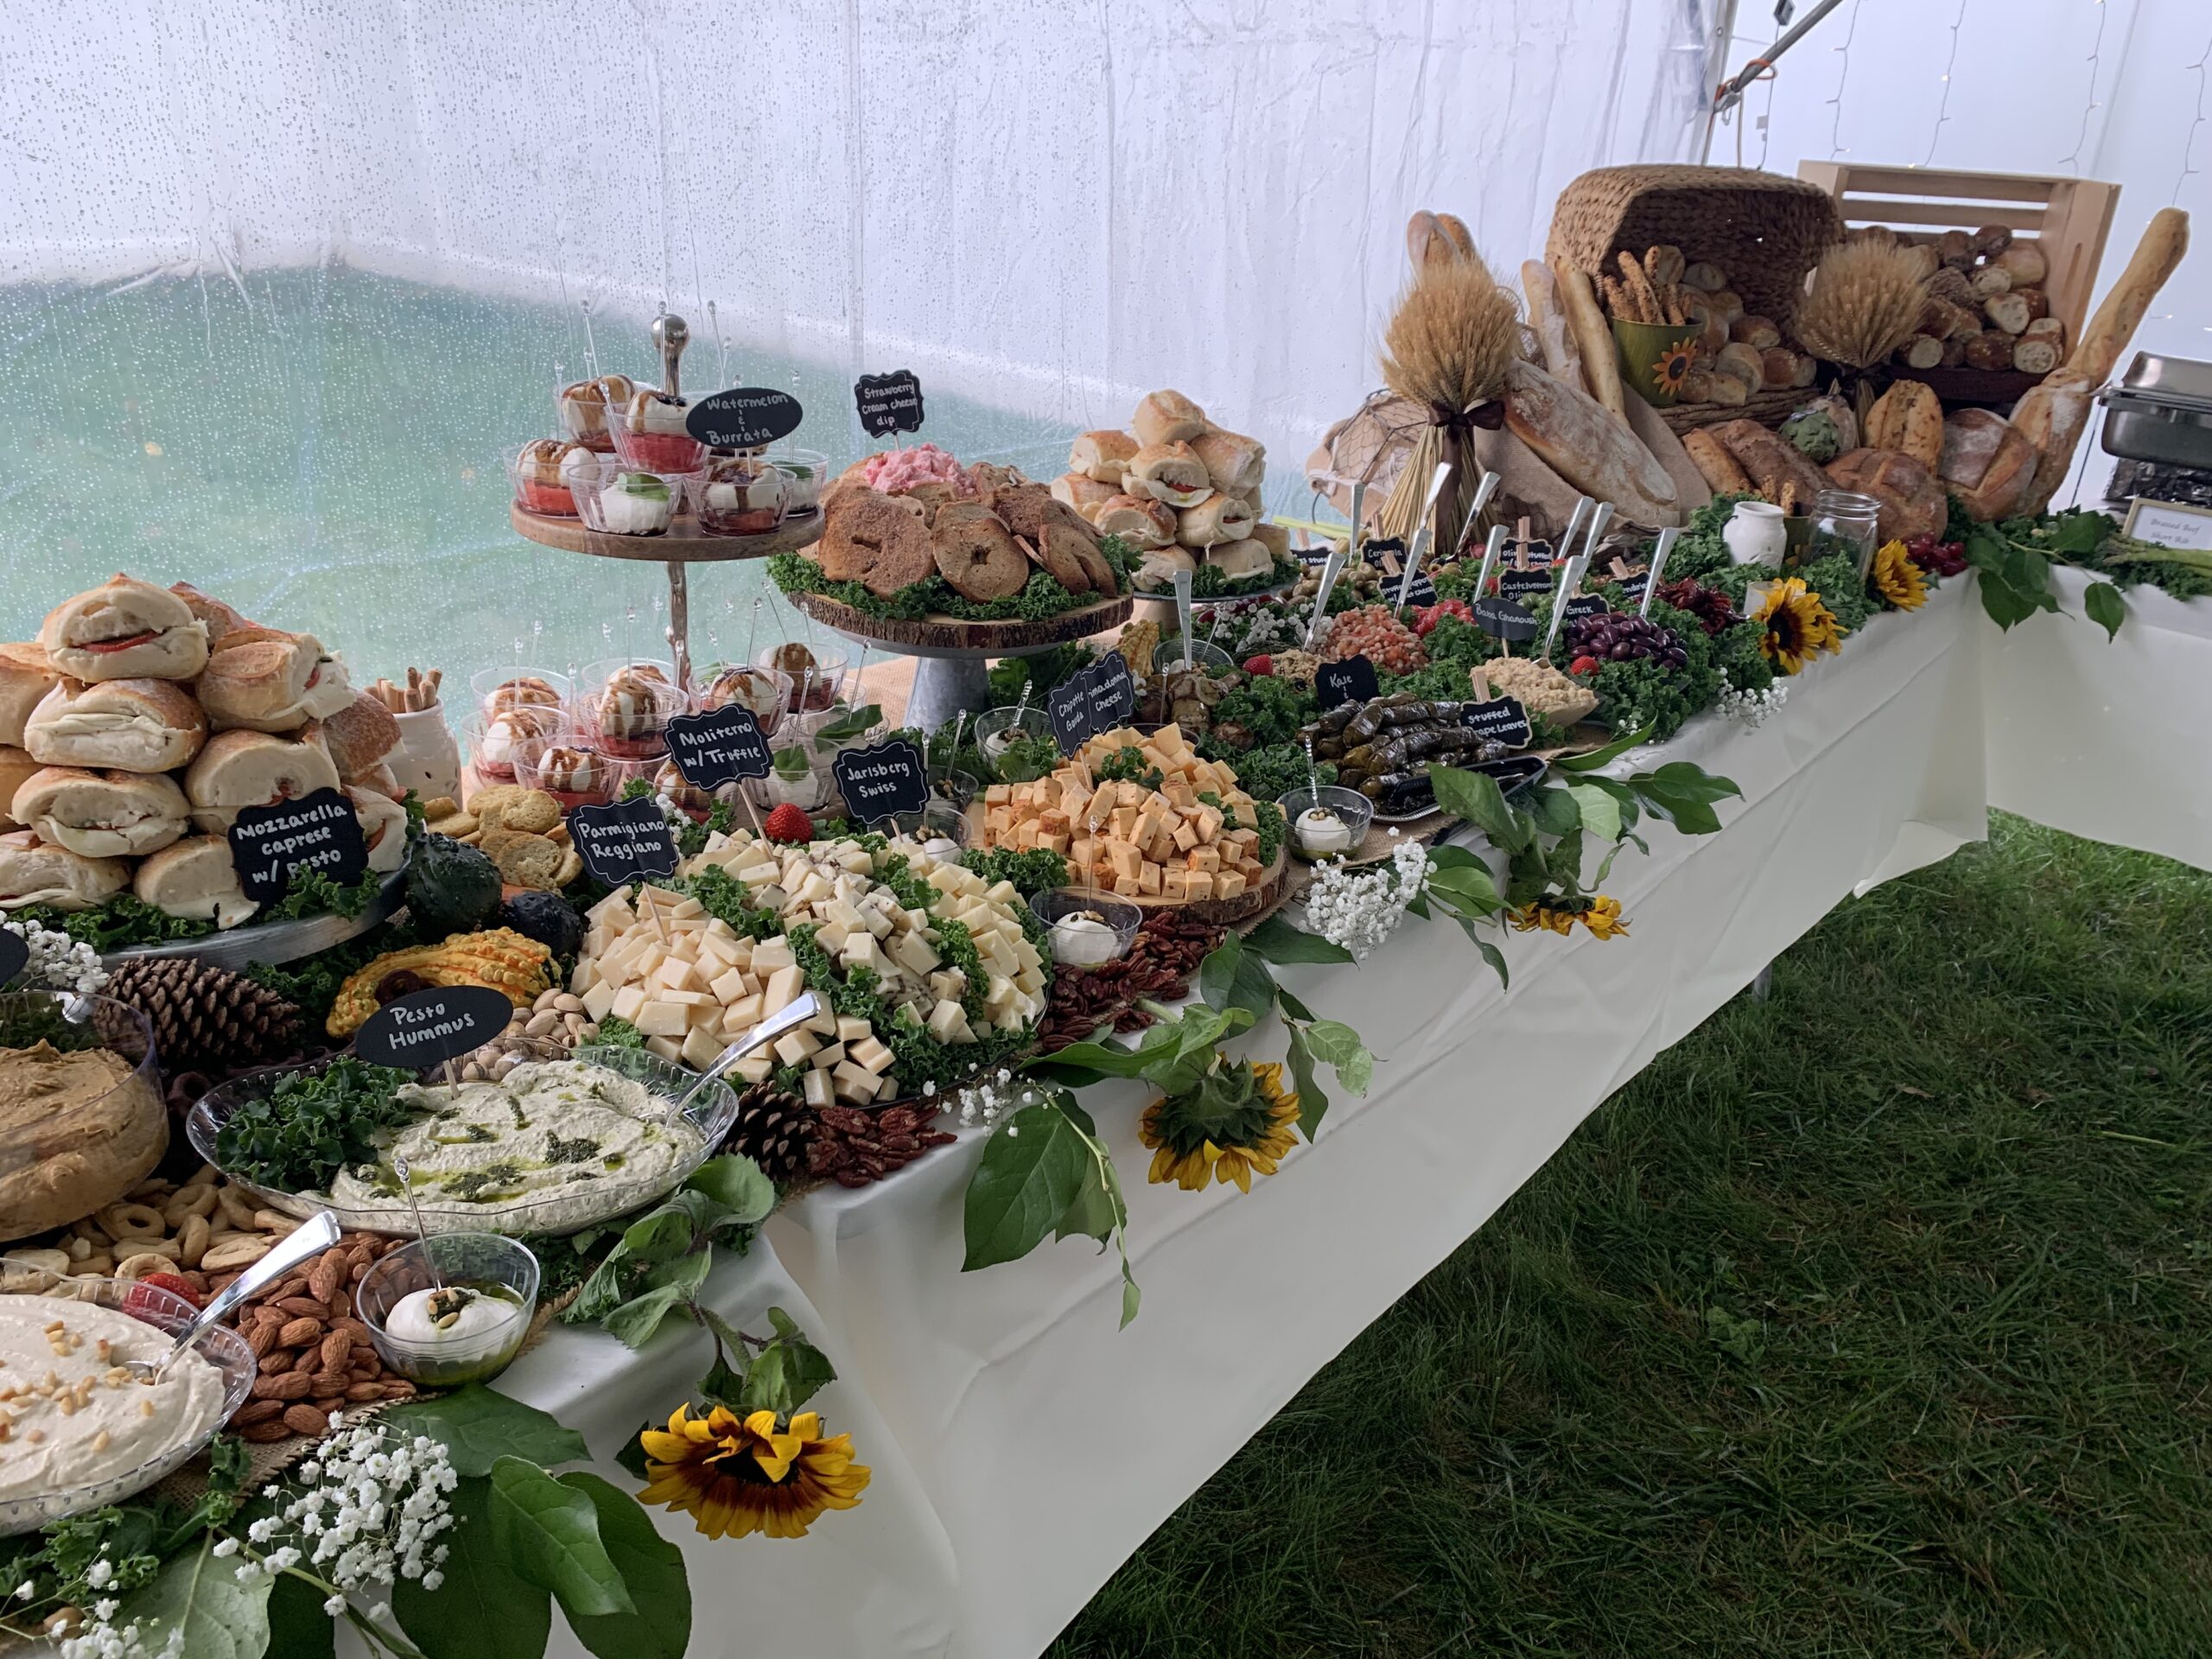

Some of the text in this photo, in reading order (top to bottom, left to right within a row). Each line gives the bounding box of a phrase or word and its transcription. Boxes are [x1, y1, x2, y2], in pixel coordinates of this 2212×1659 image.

[864, 384, 915, 398] Strawberry
[707, 395, 789, 410] Watermelon
[875, 416, 895, 426] dip
[706, 428, 773, 445] Burrata
[1566, 606, 1593, 615] Greek
[1330, 673, 1353, 688] Kale
[1058, 691, 1084, 717] Chipotle
[1065, 711, 1084, 732] Gouda
[678, 722, 753, 747] Moliterno
[848, 760, 910, 781] Jarlsberg
[859, 782, 897, 798] Swiss
[236, 804, 347, 840] Mozzarella
[578, 821, 665, 840] Parmigiano
[590, 842, 662, 860] Reggiano
[251, 859, 278, 883] w/
[389, 1002, 446, 1026] Pesto
[389, 1012, 475, 1050] Hummus
